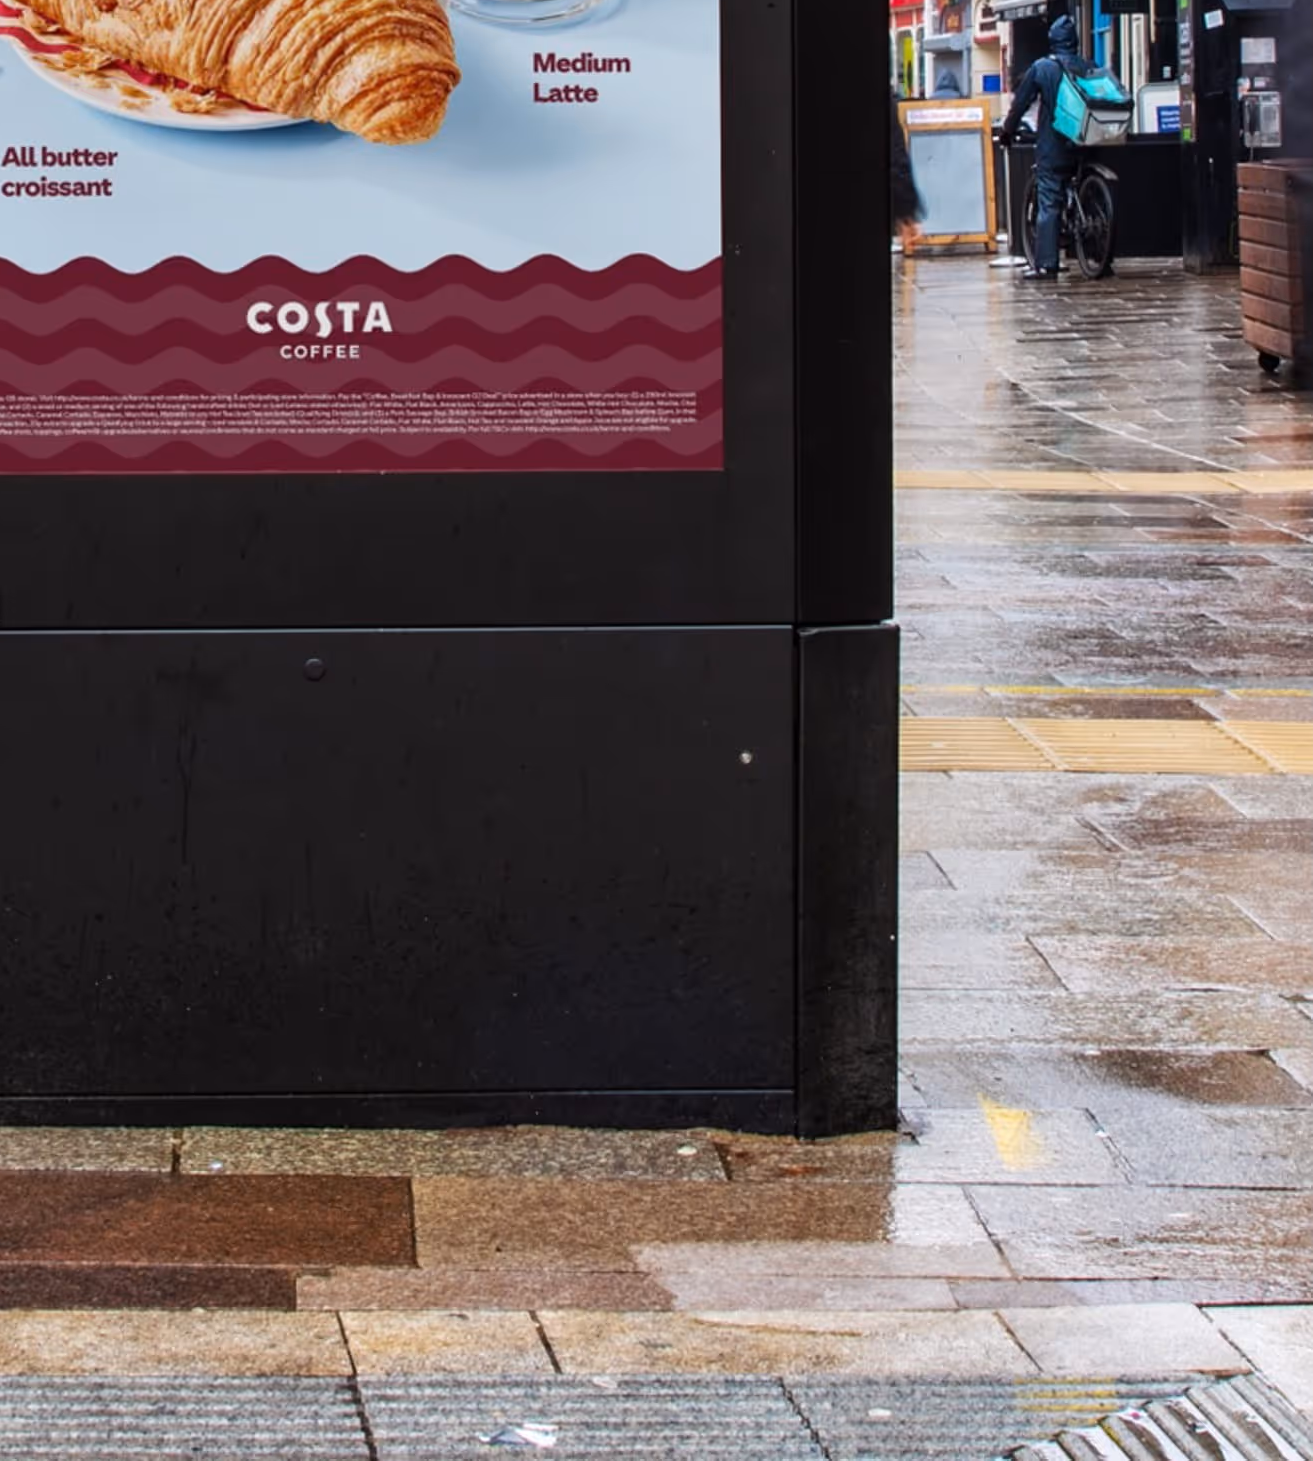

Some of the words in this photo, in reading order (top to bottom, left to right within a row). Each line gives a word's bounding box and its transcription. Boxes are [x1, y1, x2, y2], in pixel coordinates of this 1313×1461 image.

[533, 52, 631, 73] Medium
[533, 82, 599, 104] Latte
[1, 146, 38, 168] All
[41, 146, 119, 167] butter
[1, 175, 113, 197] croissant
[246, 301, 393, 338] COSTA
[280, 345, 360, 359] COFFEE
